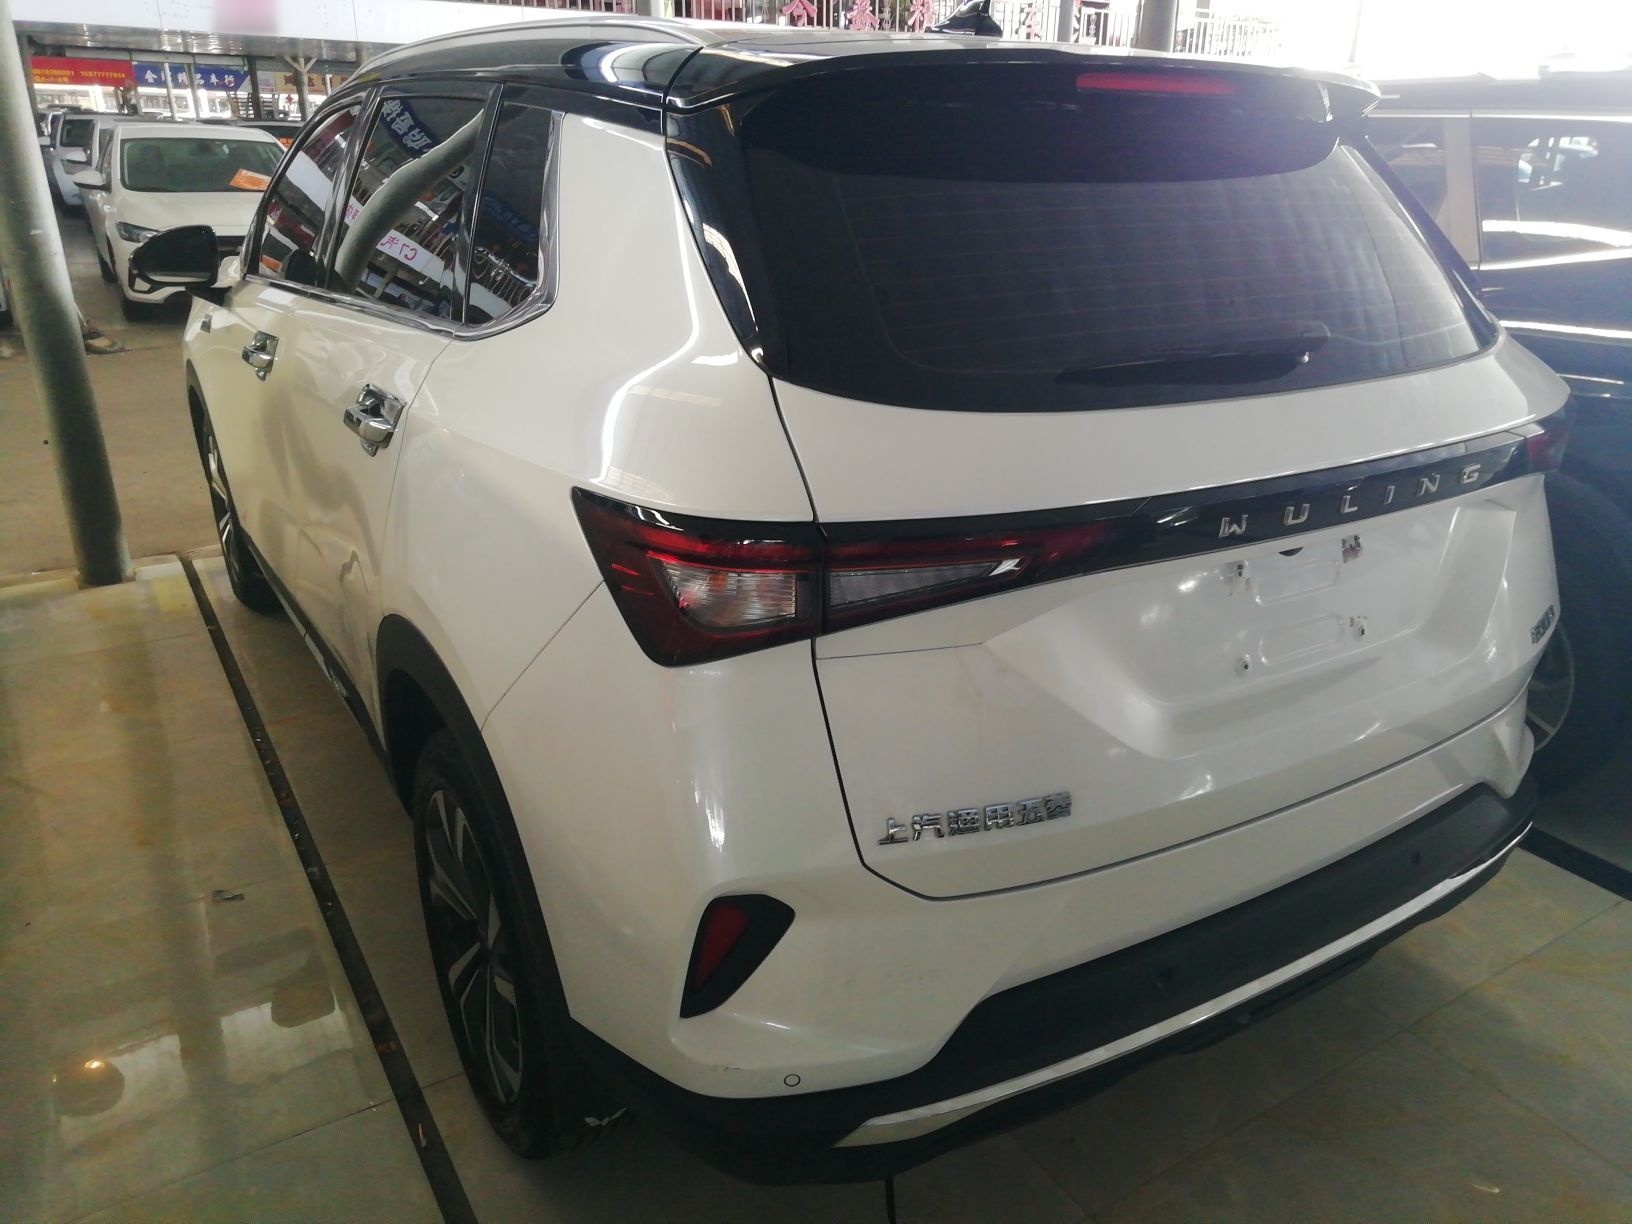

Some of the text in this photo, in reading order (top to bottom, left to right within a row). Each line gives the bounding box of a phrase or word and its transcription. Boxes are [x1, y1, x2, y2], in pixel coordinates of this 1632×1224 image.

[1217, 463, 1482, 539] WULING
[877, 791, 1073, 846] 上汽通用五菱
